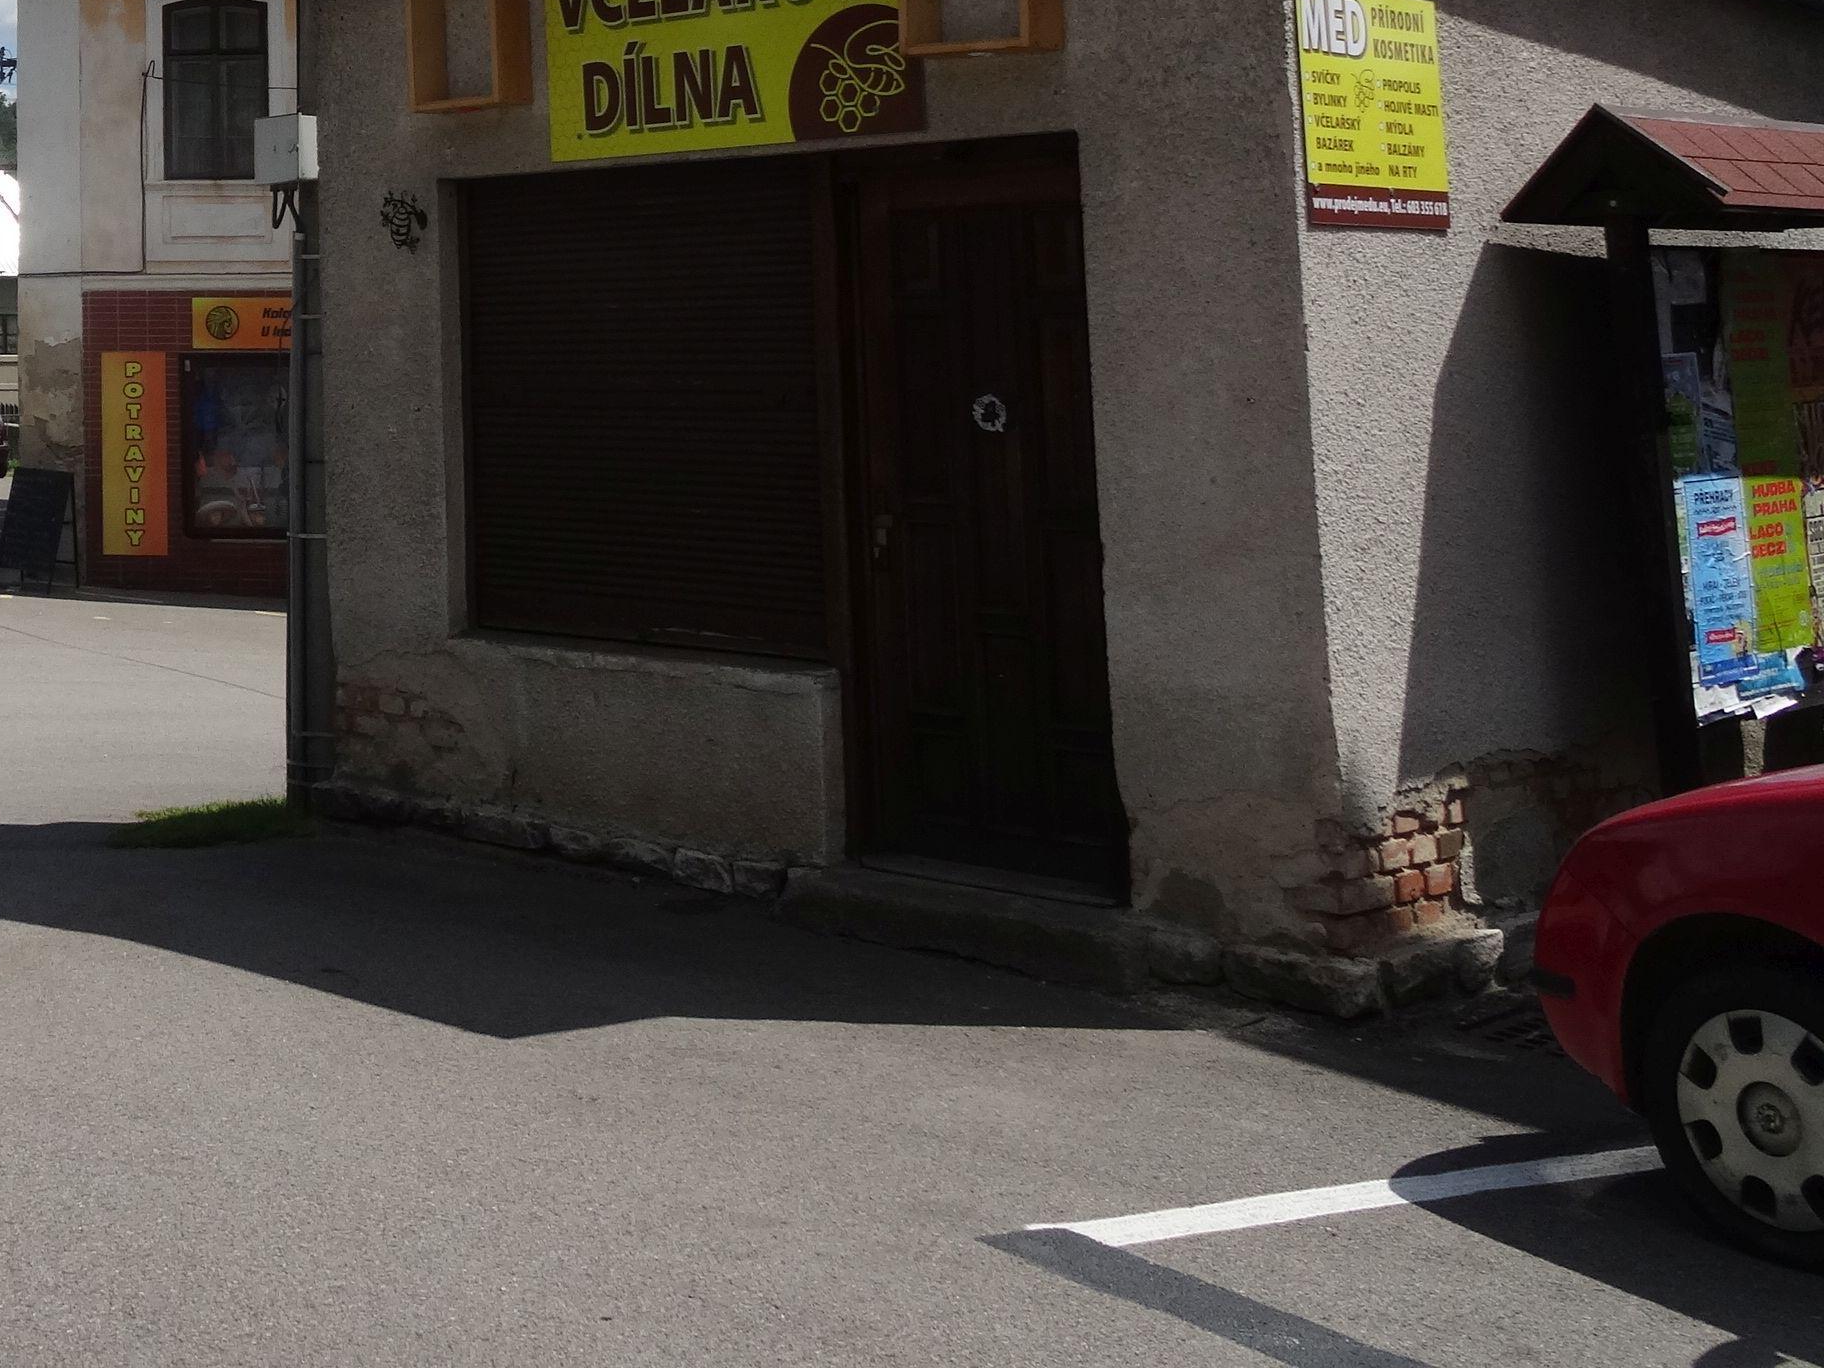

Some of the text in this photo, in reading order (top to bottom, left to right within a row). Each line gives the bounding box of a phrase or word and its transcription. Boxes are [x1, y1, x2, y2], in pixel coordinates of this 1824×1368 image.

[1371, 5, 1425, 33] PŘÍRODNÍ
[1372, 39, 1435, 65] KOSMETIKA
[1311, 68, 1341, 86] SVÍČKY
[581, 41, 764, 136] DÍLNA
[1382, 79, 1421, 94] PROPOLIS
[1313, 92, 1348, 108] BYLINKY
[1384, 100, 1439, 117] HOJIVÉ MASTI
[1314, 113, 1362, 131] VČELAŘSKÝ
[1385, 120, 1414, 136] MÝDLA
[1316, 136, 1355, 152] BAZÁREK
[1386, 143, 1425, 158] BALZÁMY
[1317, 161, 1381, 178] a mnoho jiného
[1388, 164, 1418, 179] NA RTY
[122, 361, 145, 548] POTRAVINY
[1753, 499, 1797, 517] PRAHA
